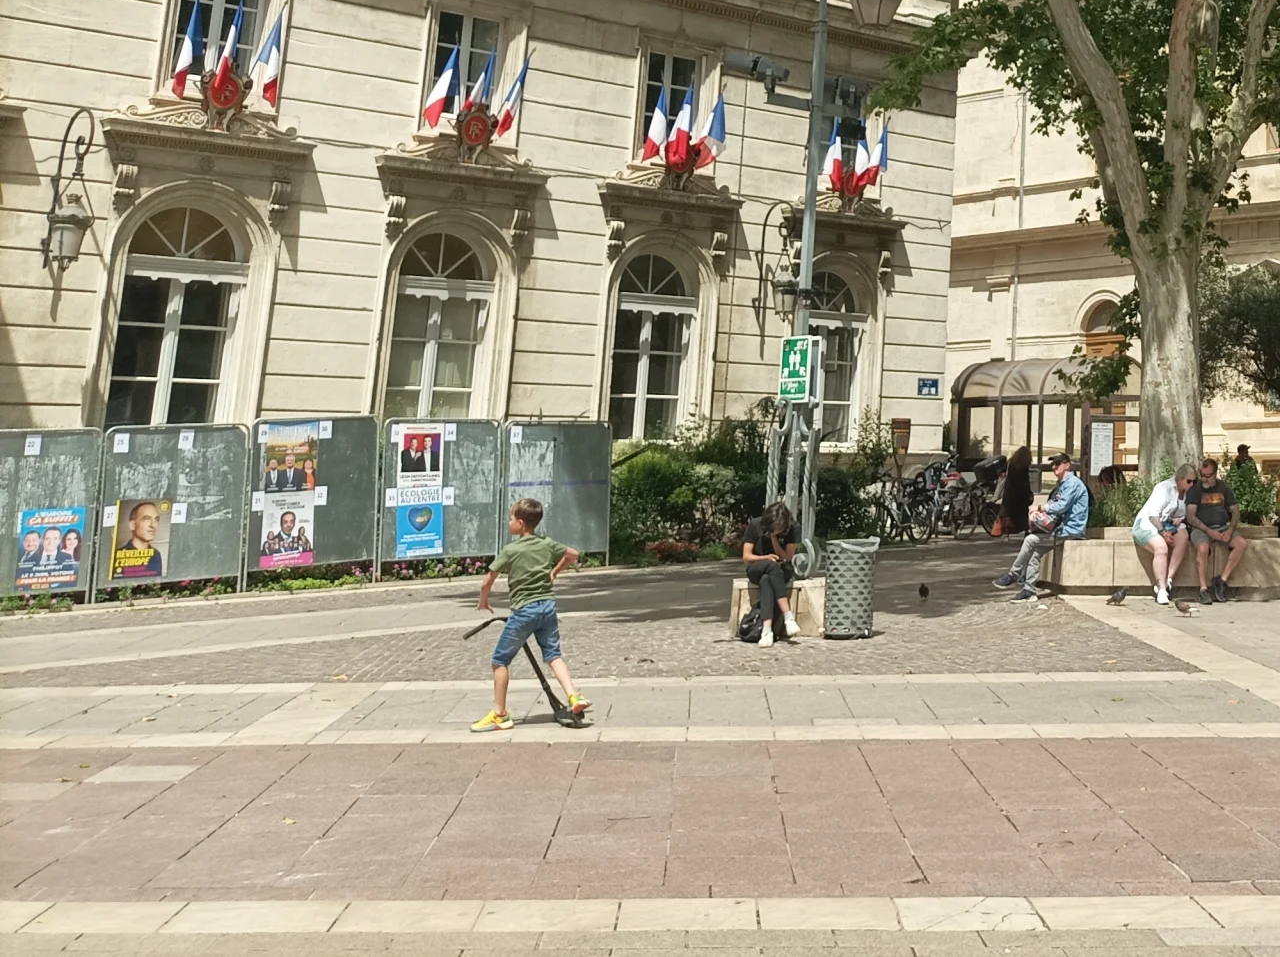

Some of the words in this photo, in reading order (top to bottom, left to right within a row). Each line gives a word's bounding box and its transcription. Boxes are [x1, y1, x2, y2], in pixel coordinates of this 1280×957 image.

[400, 488, 440, 497] ÉCOLOGIE
[413, 495, 440, 503] CENTRE
[35, 510, 73, 518] L'EUROPE
[42, 515, 72, 523] SUFFIT
[116, 548, 154, 558] RÉVEILLER
[115, 557, 151, 567] L'EUROPE
